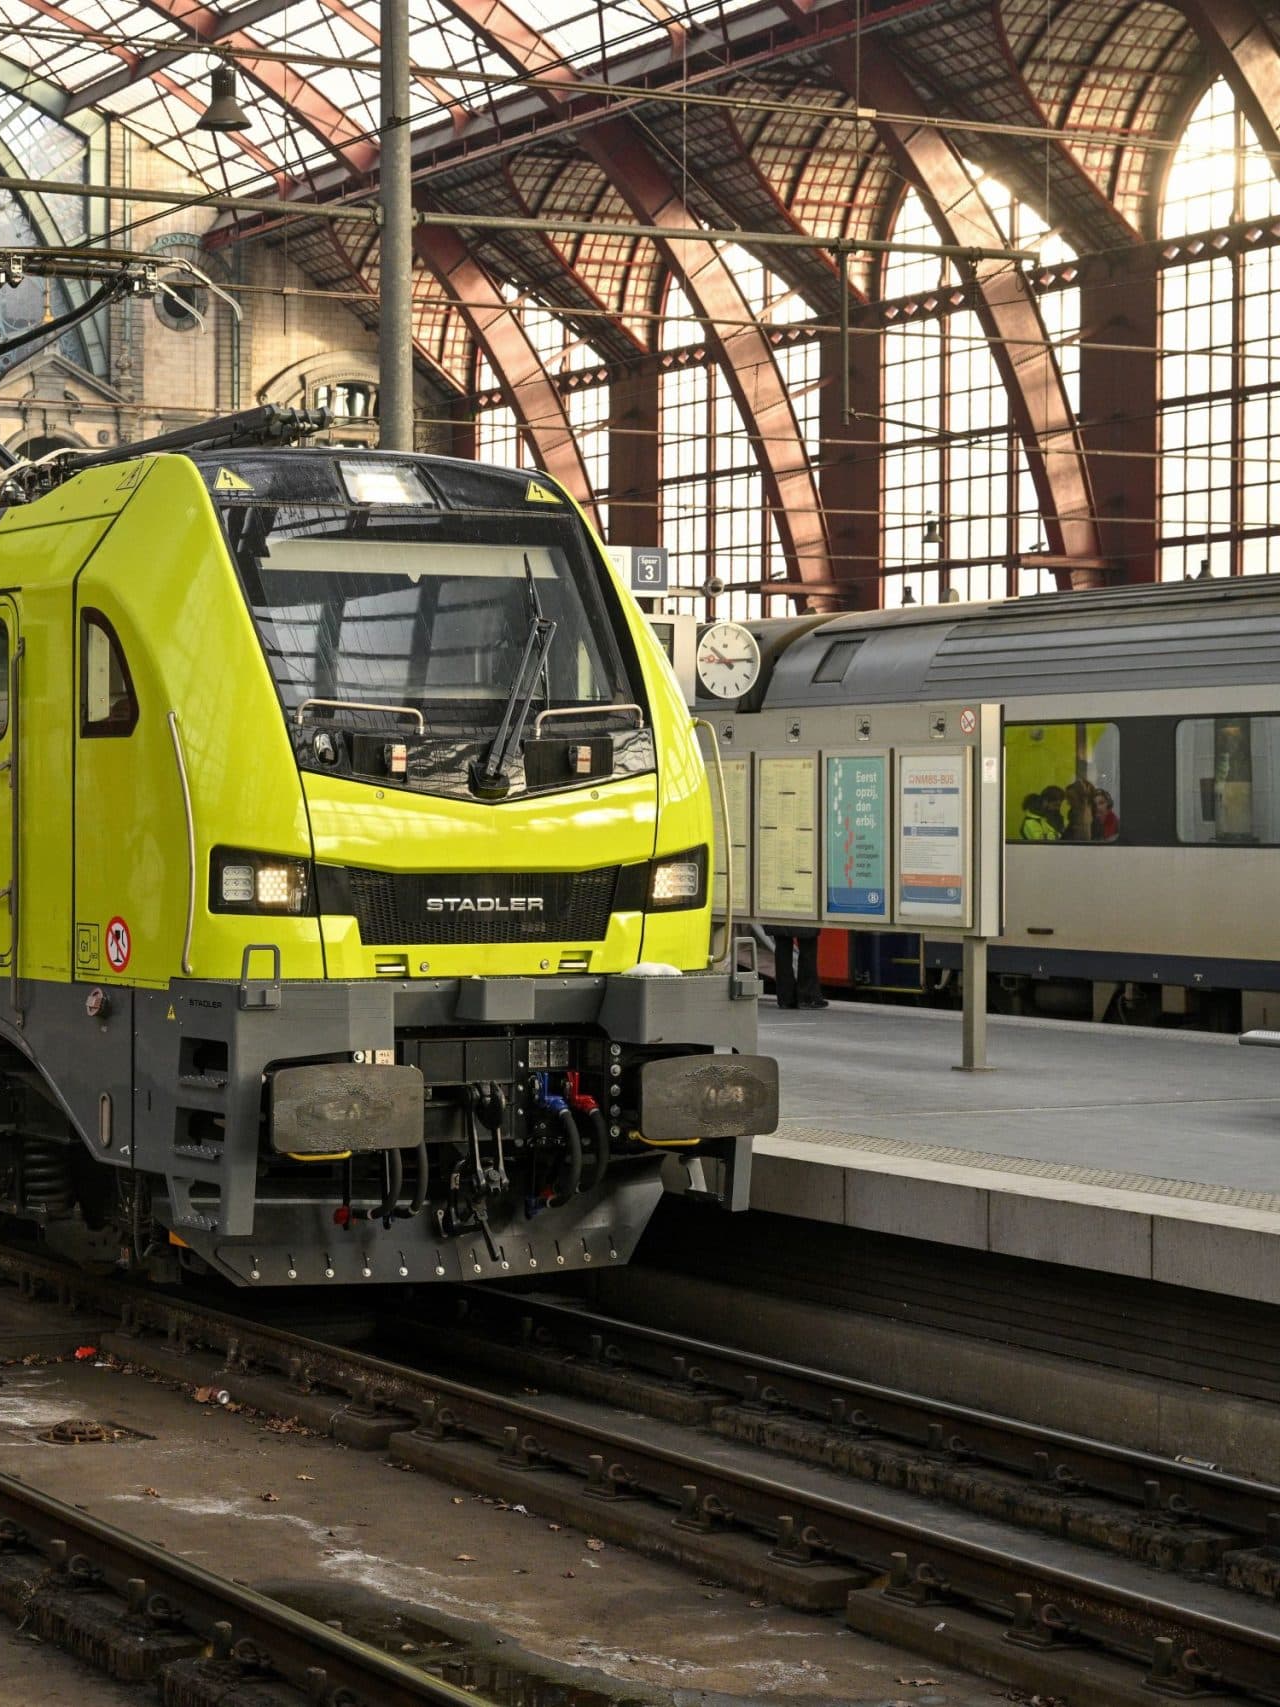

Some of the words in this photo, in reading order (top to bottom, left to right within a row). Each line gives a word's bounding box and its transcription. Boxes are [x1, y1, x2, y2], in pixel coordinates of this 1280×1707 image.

[645, 565, 654, 580] 3
[856, 771, 877, 783] Eerst
[856, 800, 871, 812] dan
[426, 897, 544, 912] STADLER
[189, 999, 222, 1009] STADLER
